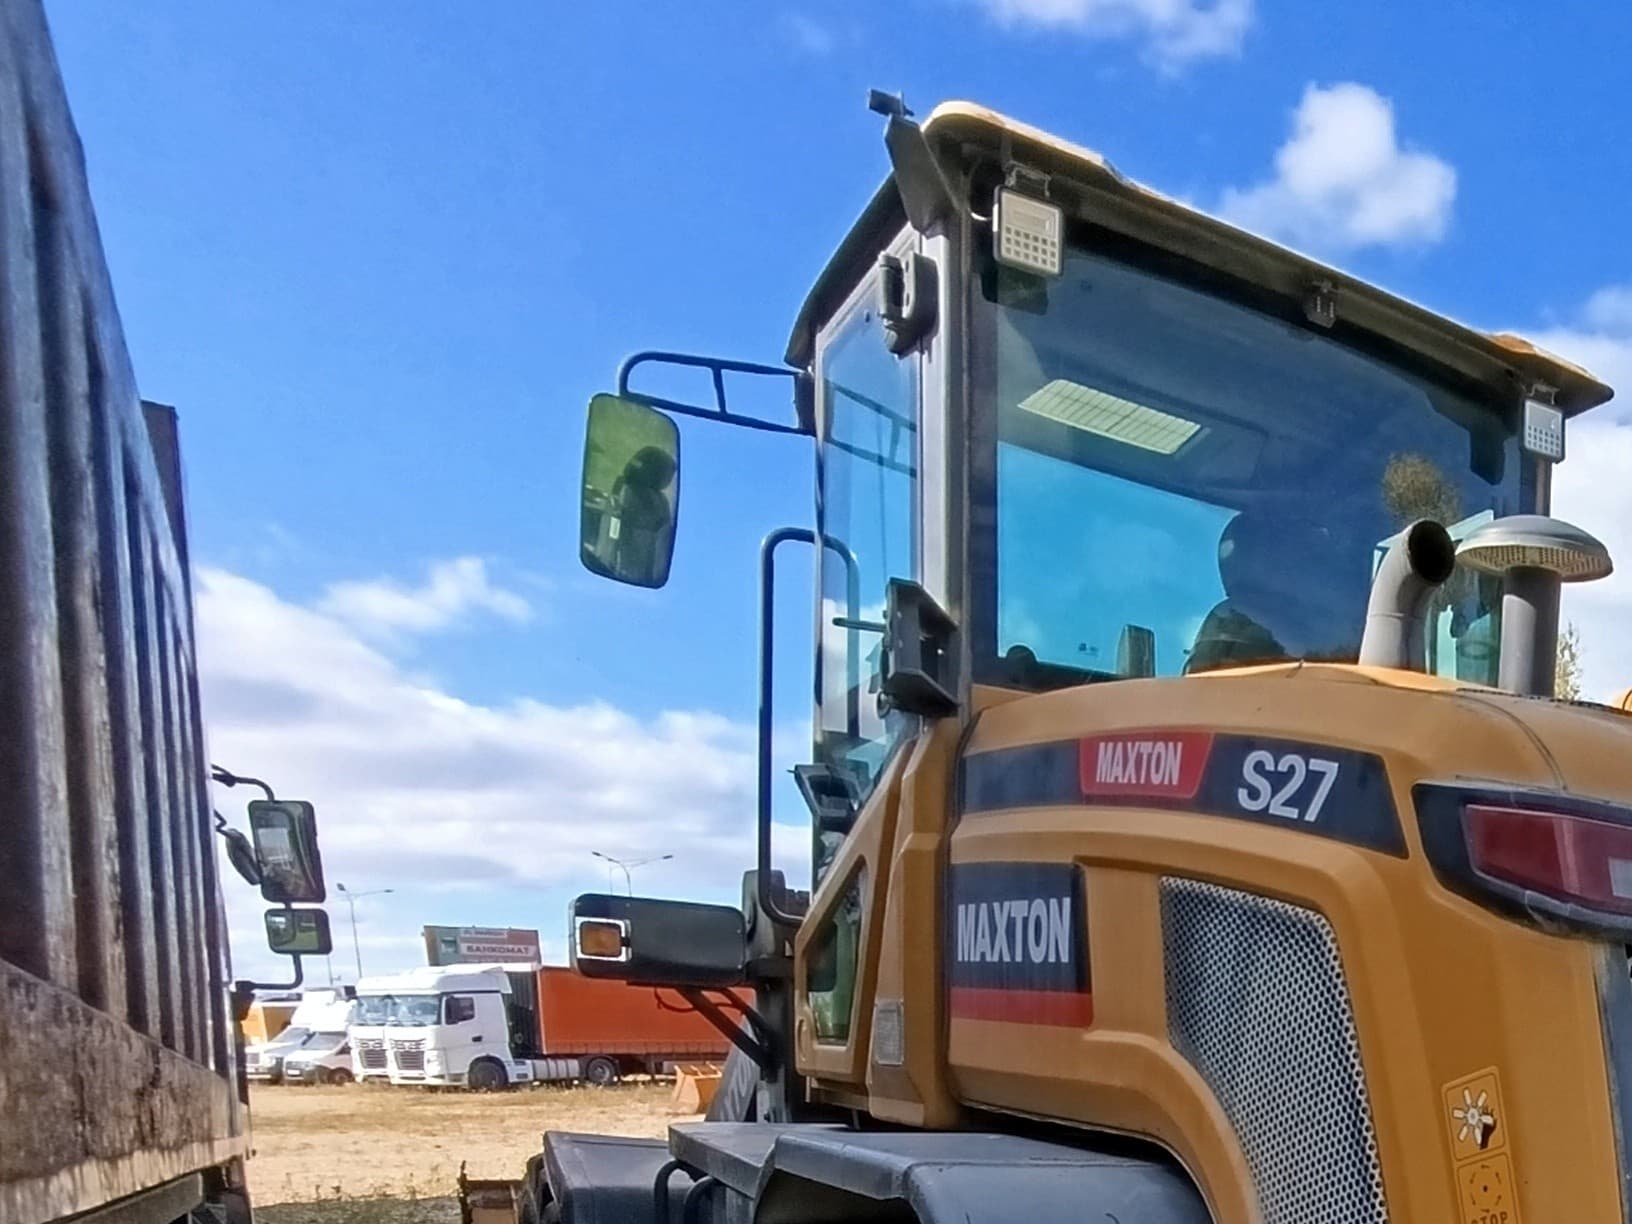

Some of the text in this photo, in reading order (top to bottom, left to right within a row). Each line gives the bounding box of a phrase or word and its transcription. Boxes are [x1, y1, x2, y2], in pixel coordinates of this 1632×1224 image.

[1096, 741, 1341, 823] MAXTON S27
[466, 944, 529, 955] БАНКОМАТ
[956, 897, 1072, 964] MAXTON
